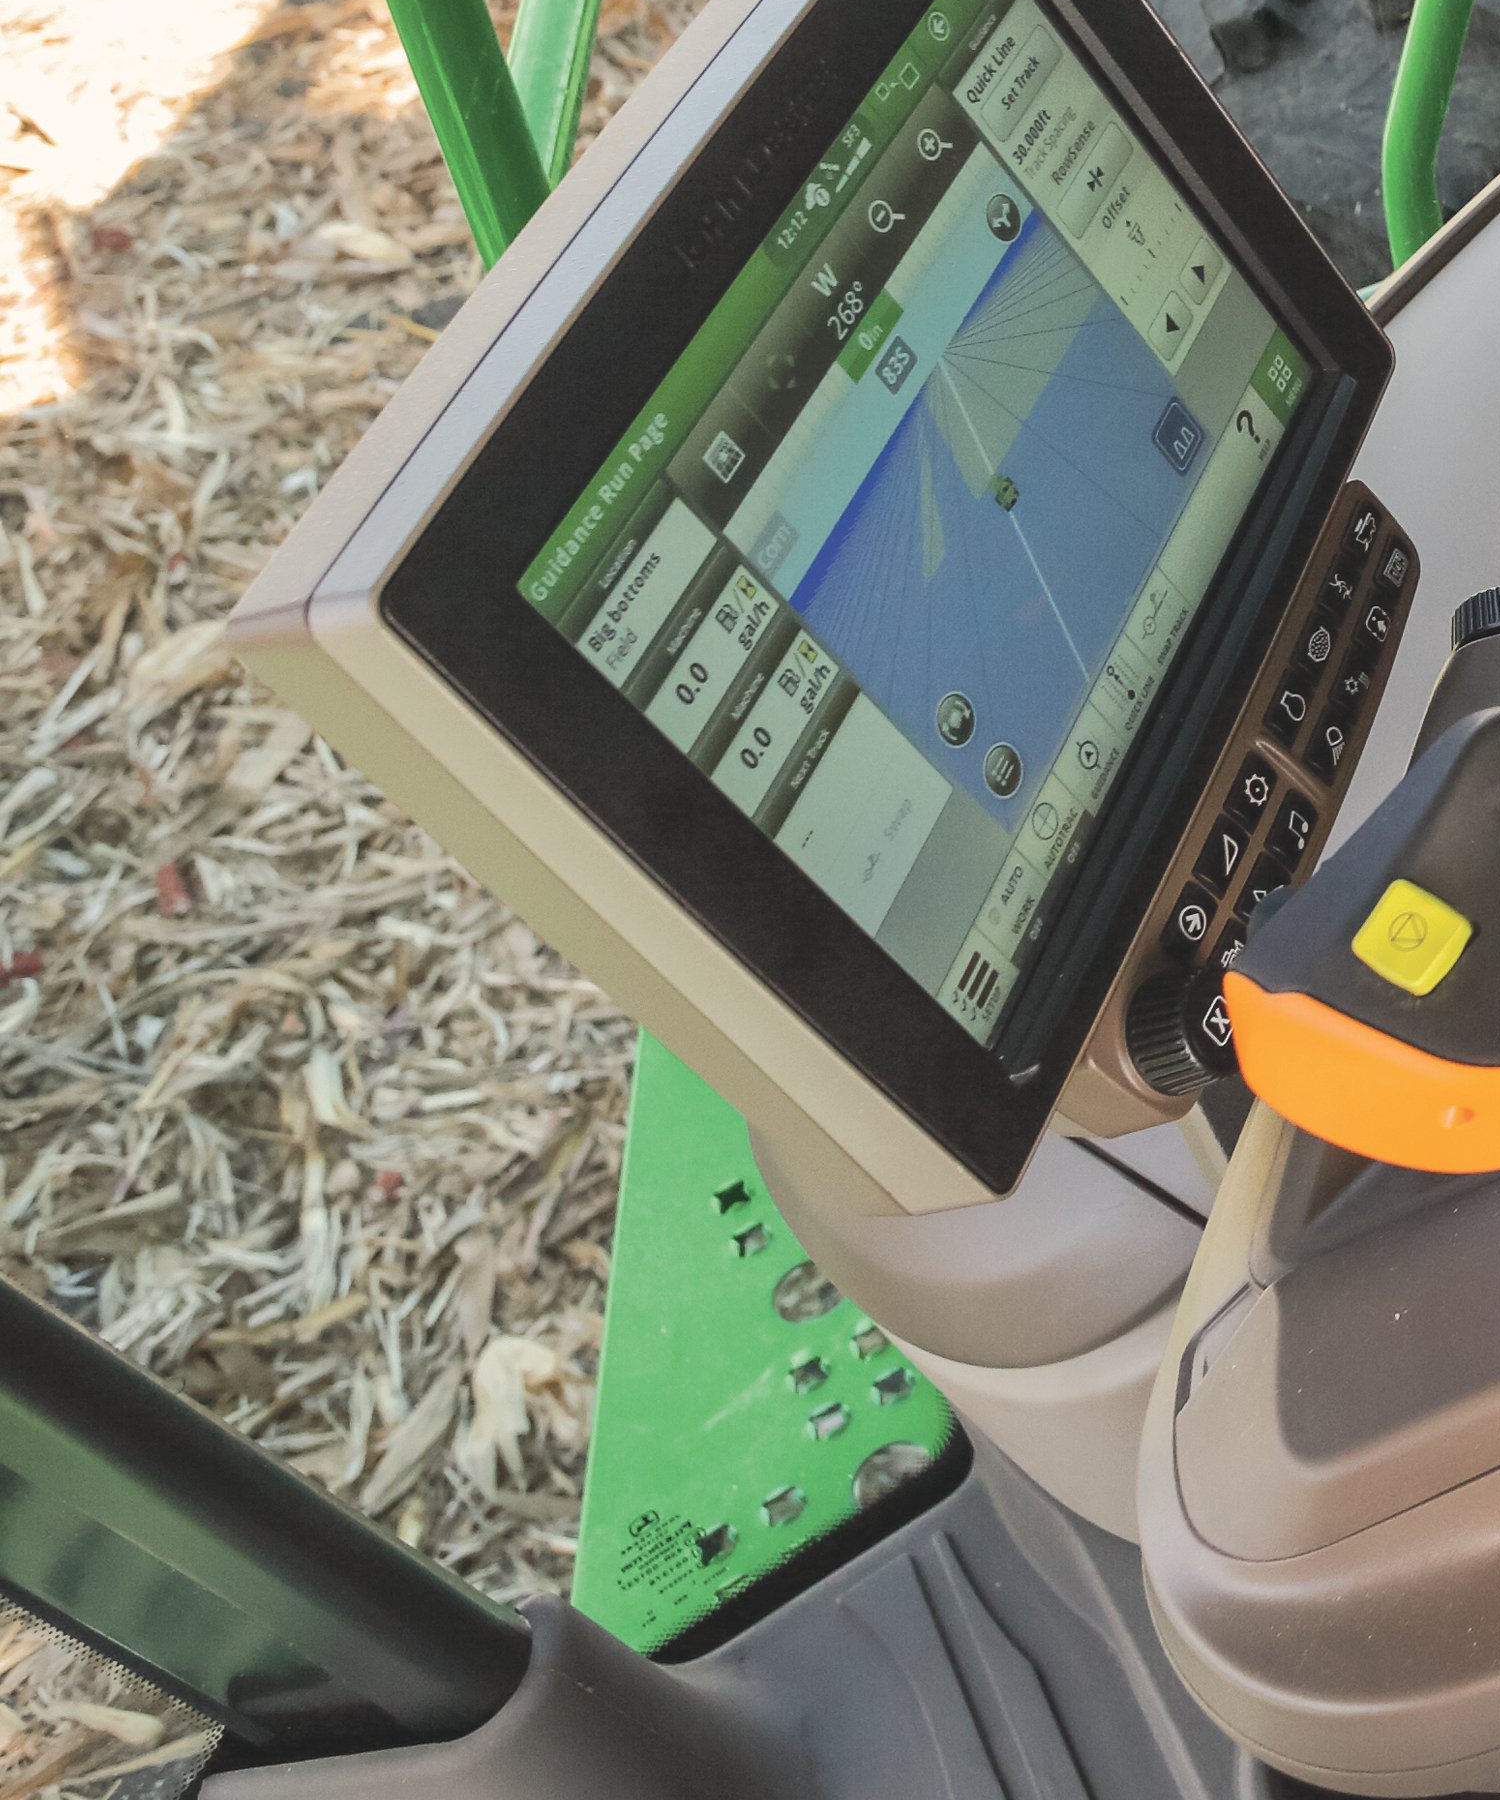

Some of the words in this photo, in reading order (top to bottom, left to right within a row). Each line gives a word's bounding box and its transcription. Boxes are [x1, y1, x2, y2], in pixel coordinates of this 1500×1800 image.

[964, 60, 998, 107] Quick
[990, 31, 1016, 68] Line
[999, 83, 1019, 112] Set
[1013, 52, 1040, 91] Track
[840, 121, 862, 150] SF3
[1011, 106, 1052, 166] 30.000ft
[1023, 144, 1048, 181] Track
[1042, 102, 1077, 155] Spacing
[1050, 116, 1096, 186] RowSense
[775, 207, 809, 252] 12:12
[1100, 182, 1130, 232] Offset
[810, 261, 841, 302] W
[526, 498, 607, 605] Guidance
[596, 457, 635, 506] Run
[626, 407, 674, 468] Page
[598, 536, 637, 589] Location
[587, 618, 617, 656] Big
[606, 547, 662, 624] bottoms
[733, 595, 774, 652] gal/h
[1169, 604, 1189, 640] TRACK
[605, 627, 639, 672] Field
[666, 604, 702, 656] Machine
[673, 658, 710, 708] 0.0
[730, 669, 765, 721] Machine
[795, 659, 834, 715] gal/h
[1123, 694, 1145, 733] QUICK
[1140, 673, 1155, 699] LINE
[738, 723, 773, 772] 0.0
[789, 758, 811, 790] Next
[807, 725, 830, 761] Track
[1090, 746, 1120, 801] GUIDANCE
[1042, 805, 1078, 871] AUTOTRAC
[999, 863, 1024, 907] AUTO
[1010, 892, 1035, 937] WORK
[981, 984, 1003, 1023] SETUP
